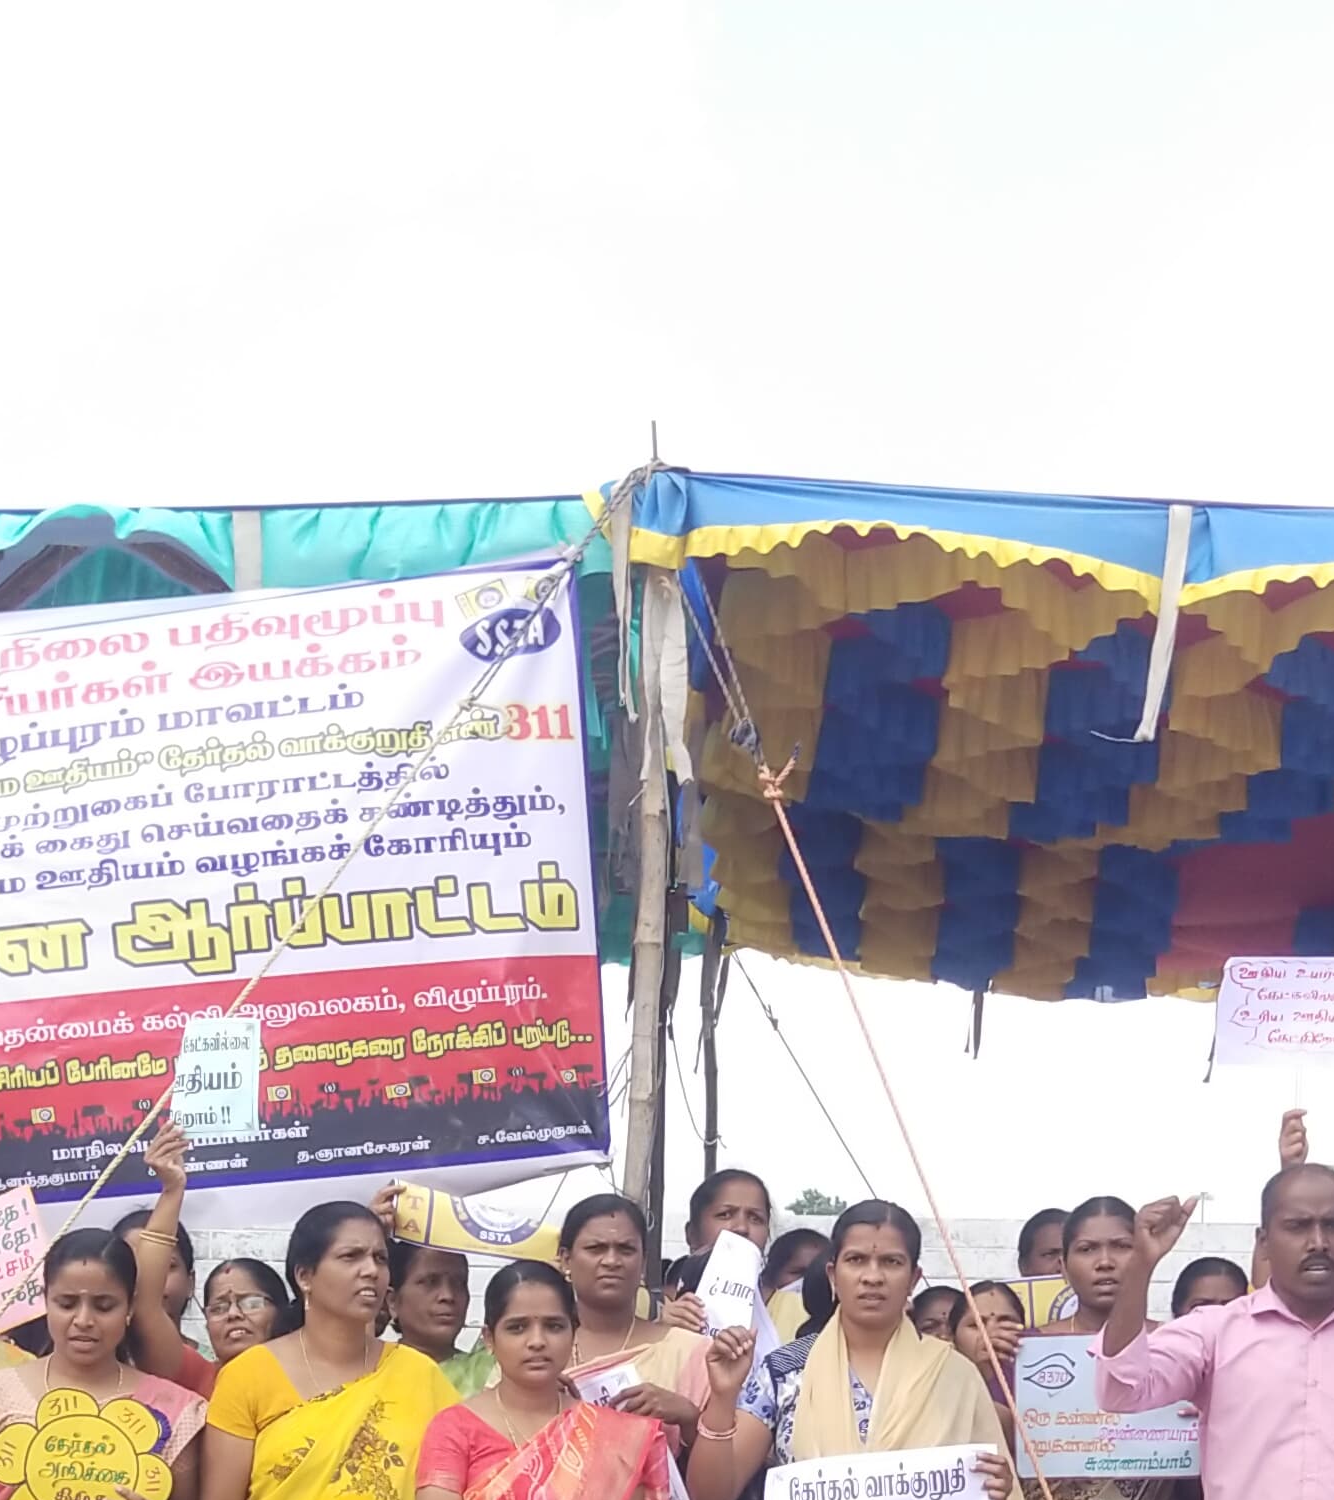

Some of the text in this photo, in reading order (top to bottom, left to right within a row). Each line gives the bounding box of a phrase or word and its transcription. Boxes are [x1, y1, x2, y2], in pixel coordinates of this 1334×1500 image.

[168, 588, 445, 650] பதிவுமூப்பு
[475, 613, 545, 658] SSTA
[189, 634, 422, 690] இயக்கம்
[157, 683, 364, 732] மாவட்டம்
[158, 730, 274, 775] தேர்தல்
[278, 719, 433, 758] வாக்குறுதி
[505, 702, 575, 741] 311
[183, 756, 449, 804] போராட்டத்தில்
[35, 829, 130, 855] கைது
[140, 798, 348, 843] செய்வதைக்
[35, 850, 185, 891] ஊதியம்
[364, 822, 532, 858] கோரியும்
[112, 860, 579, 975] ஆர்ப்பாட்டம்
[233, 986, 406, 1027] அலுவலகம்,
[413, 976, 548, 1011] விழுப்புரம்.
[273, 1033, 406, 1073] தலைநகரை
[413, 1021, 508, 1056] நோக்கிப்
[52, 1139, 124, 1162] மாநில
[297, 1135, 431, 1164] த.ஞானசேகரன்
[477, 1120, 593, 1146] ச.வேல்முருகன்
[479, 1230, 512, 1244] SSTA
[47, 1395, 78, 1417] 311
[117, 1407, 147, 1435] 311
[44, 1432, 116, 1458] தேர்தல்
[145, 1466, 161, 1492] 311
